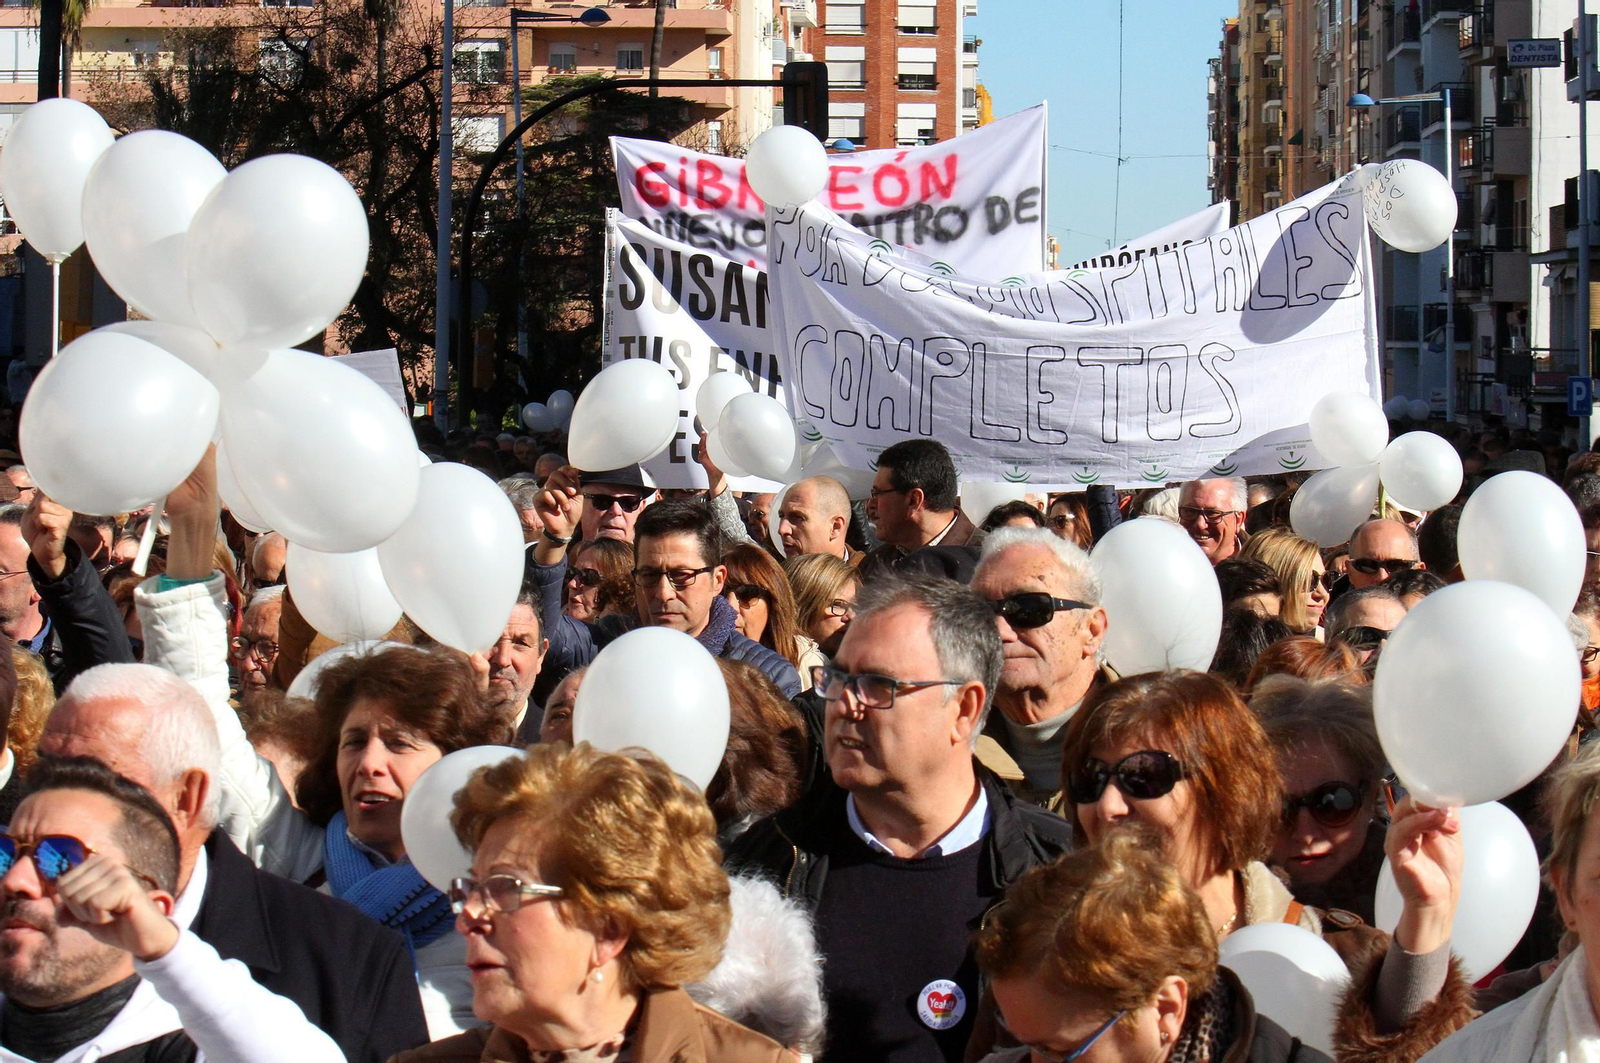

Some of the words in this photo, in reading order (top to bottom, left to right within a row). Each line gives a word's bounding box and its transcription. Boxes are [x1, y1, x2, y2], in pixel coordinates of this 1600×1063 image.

[1511, 54, 1559, 63] DENTISTA
[985, 186, 1041, 236] DE
[794, 324, 1242, 446] COMPLETOS
[1572, 381, 1587, 411] P
